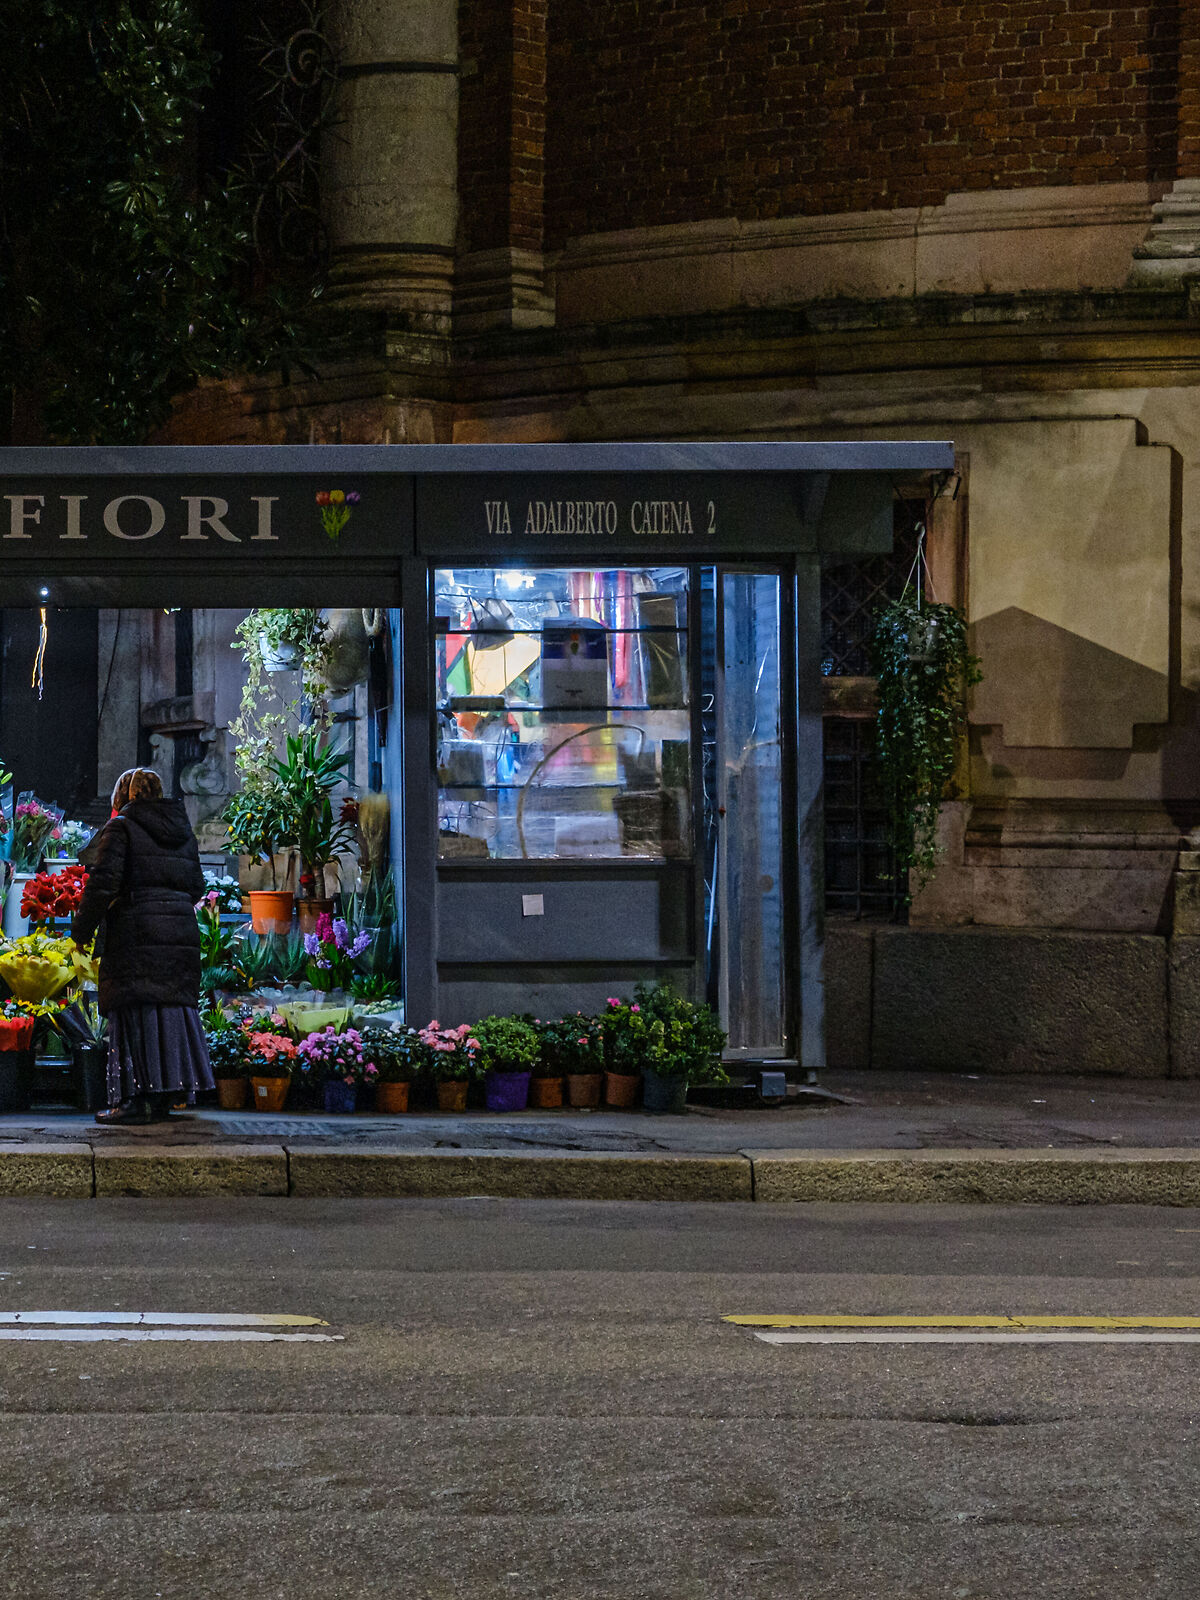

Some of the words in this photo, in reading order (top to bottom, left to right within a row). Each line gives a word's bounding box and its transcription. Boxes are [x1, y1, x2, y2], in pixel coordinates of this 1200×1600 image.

[3, 494, 280, 542] FIORI
[484, 501, 512, 534] VIA
[524, 501, 618, 535] ADALBERTO
[631, 501, 694, 535] CATENA
[707, 501, 716, 534] 2
